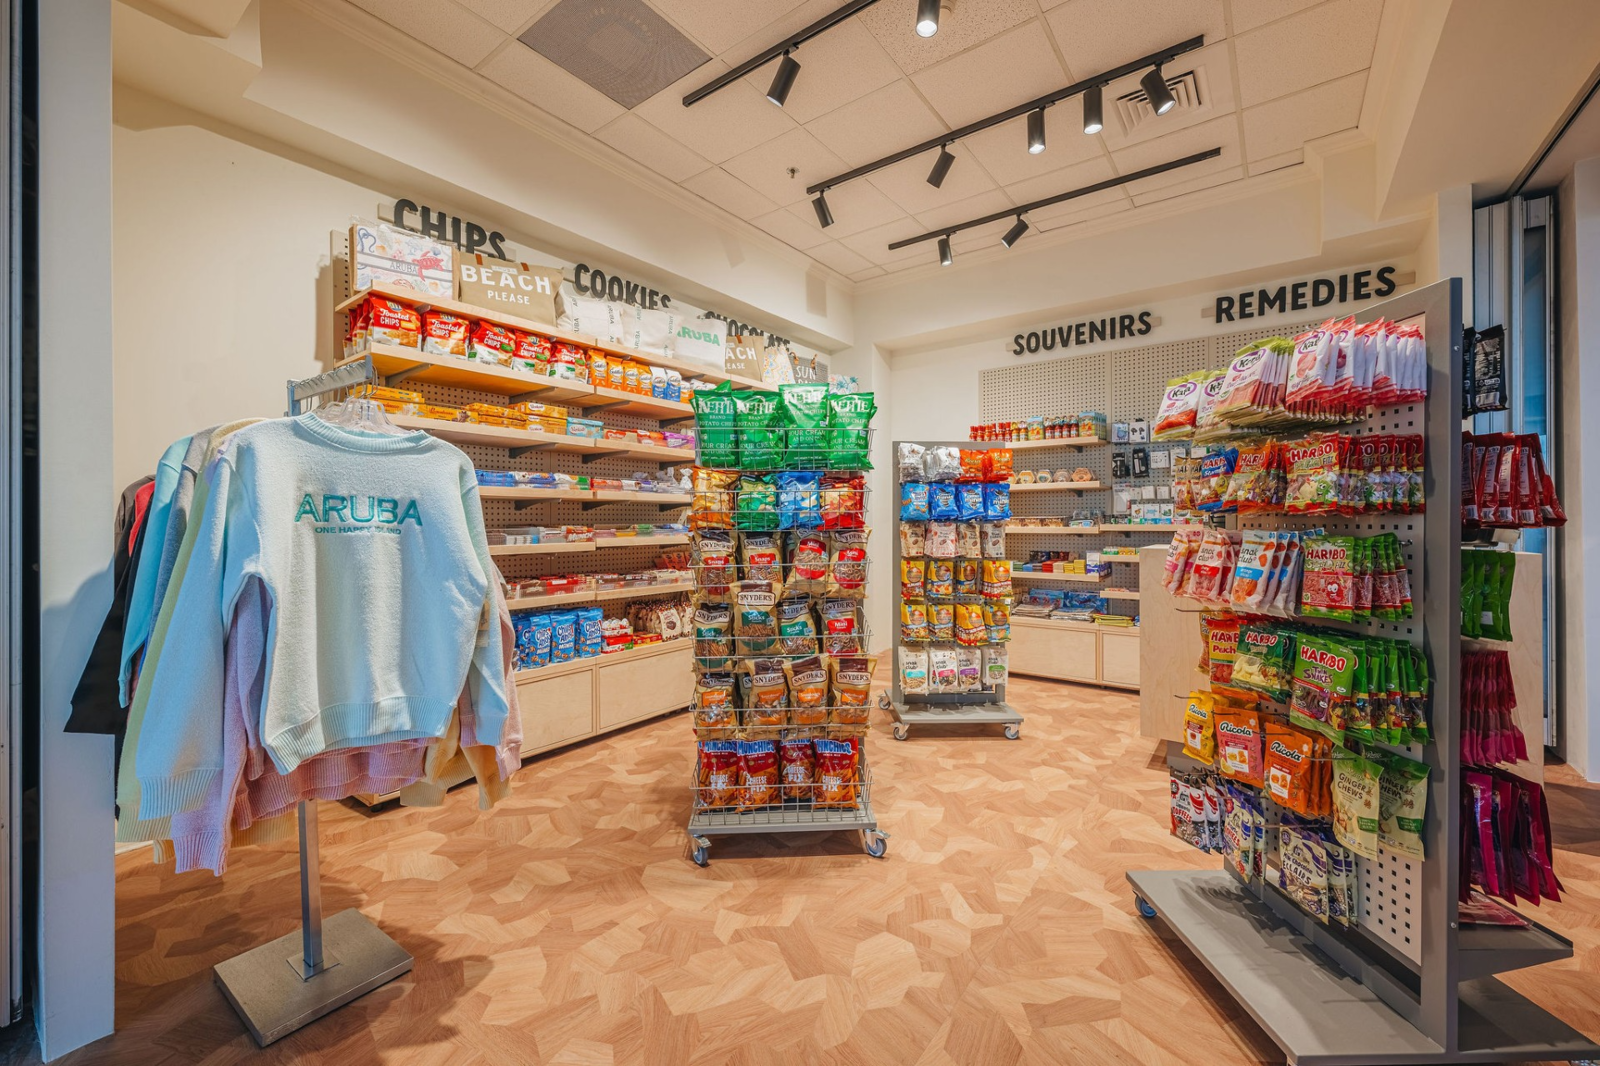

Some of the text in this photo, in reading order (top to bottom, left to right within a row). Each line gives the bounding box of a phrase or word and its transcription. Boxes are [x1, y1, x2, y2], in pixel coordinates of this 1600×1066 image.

[393, 198, 506, 261] CHIPS
[389, 261, 418, 274] ARUBA
[460, 264, 552, 296] BEACH
[574, 263, 672, 310] COOKIES
[487, 290, 530, 305] PLEASE
[1215, 266, 1397, 324] REMEDIES
[380, 308, 410, 321] Toasted
[380, 316, 400, 327] CHIPS
[431, 319, 460, 332] Toasted
[431, 328, 450, 338] CHIPS
[486, 331, 509, 344] Toasted
[1012, 311, 1152, 356] SOUVENIRS
[484, 338, 501, 349] CHIPS
[725, 347, 757, 361] ACH
[725, 362, 746, 370] EASE
[795, 365, 817, 380] SUN
[1203, 456, 1227, 468] HARIB
[294, 493, 423, 526] ARUBA
[315, 526, 337, 534] ONE
[1305, 548, 1347, 560] HARIBO
[1210, 631, 1239, 644] HARIB
[1300, 645, 1347, 673] HARIBO
[1188, 704, 1208, 719] Ricola
[1219, 721, 1253, 737] Ricola
[1270, 741, 1302, 763] Ricola
[788, 774, 804, 782] FIX
[1338, 772, 1367, 792] GINGER
[1380, 777, 1405, 792] INGER
[750, 784, 768, 794] FIX
[823, 784, 839, 792] FIX
[1337, 781, 1364, 800] CHEWS
[1172, 806, 1193, 824] TOFFEES
[1282, 859, 1312, 886] ECLAIRS
